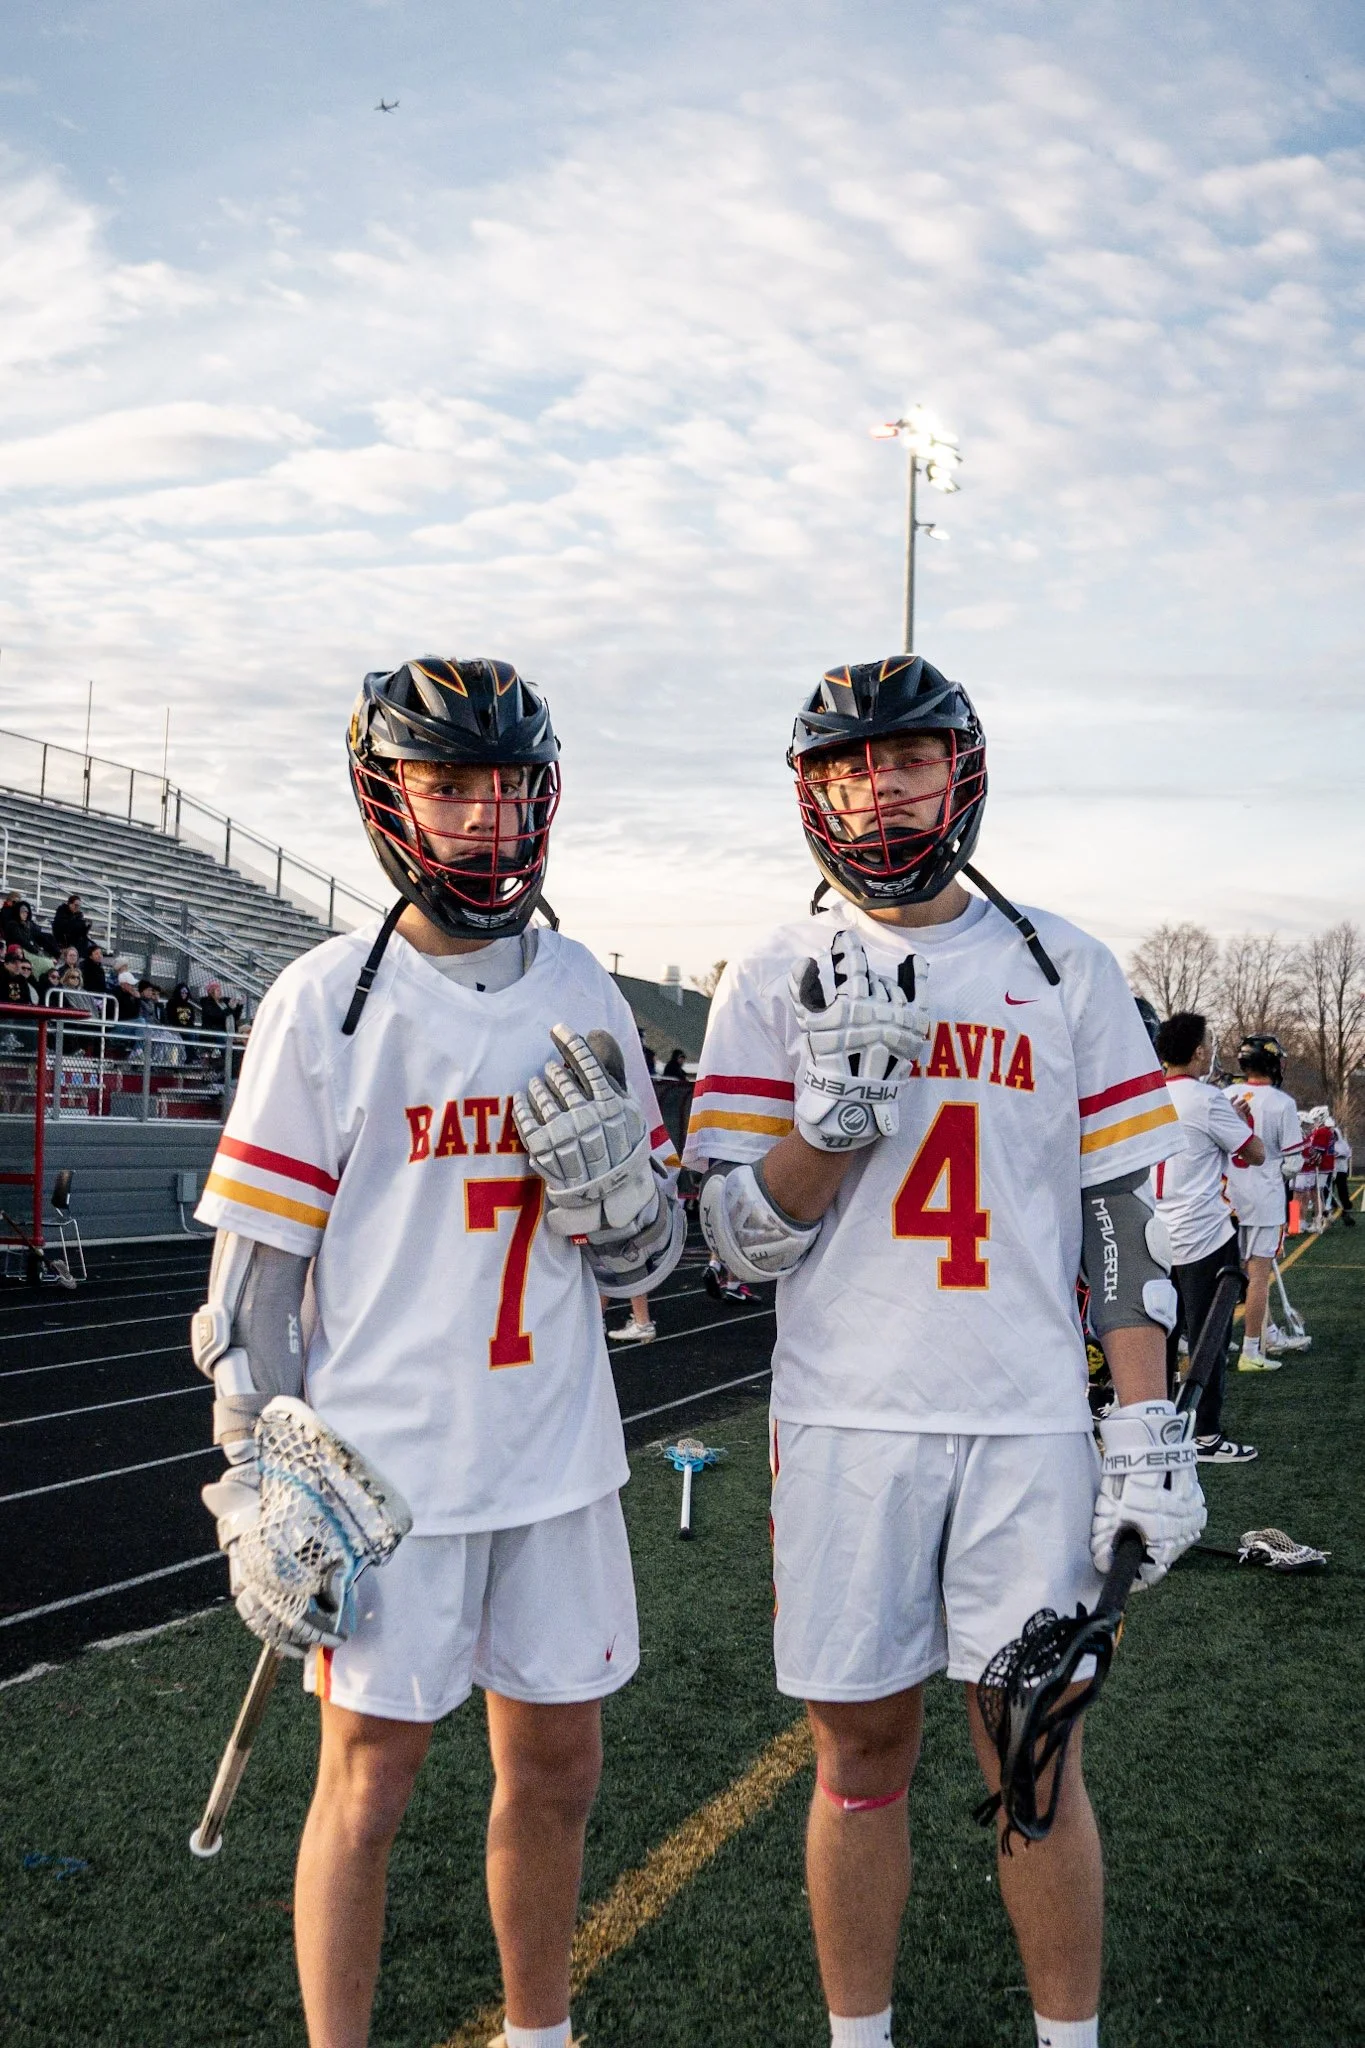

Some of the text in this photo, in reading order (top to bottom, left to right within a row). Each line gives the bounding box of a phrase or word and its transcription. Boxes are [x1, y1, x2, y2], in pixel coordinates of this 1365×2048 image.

[909, 1021, 1035, 1092] AVIA
[890, 1101, 991, 1291] 4
[463, 1175, 545, 1371] 7
[1091, 1198, 1118, 1304] MAVERIK
[288, 1313, 299, 1354] STX
